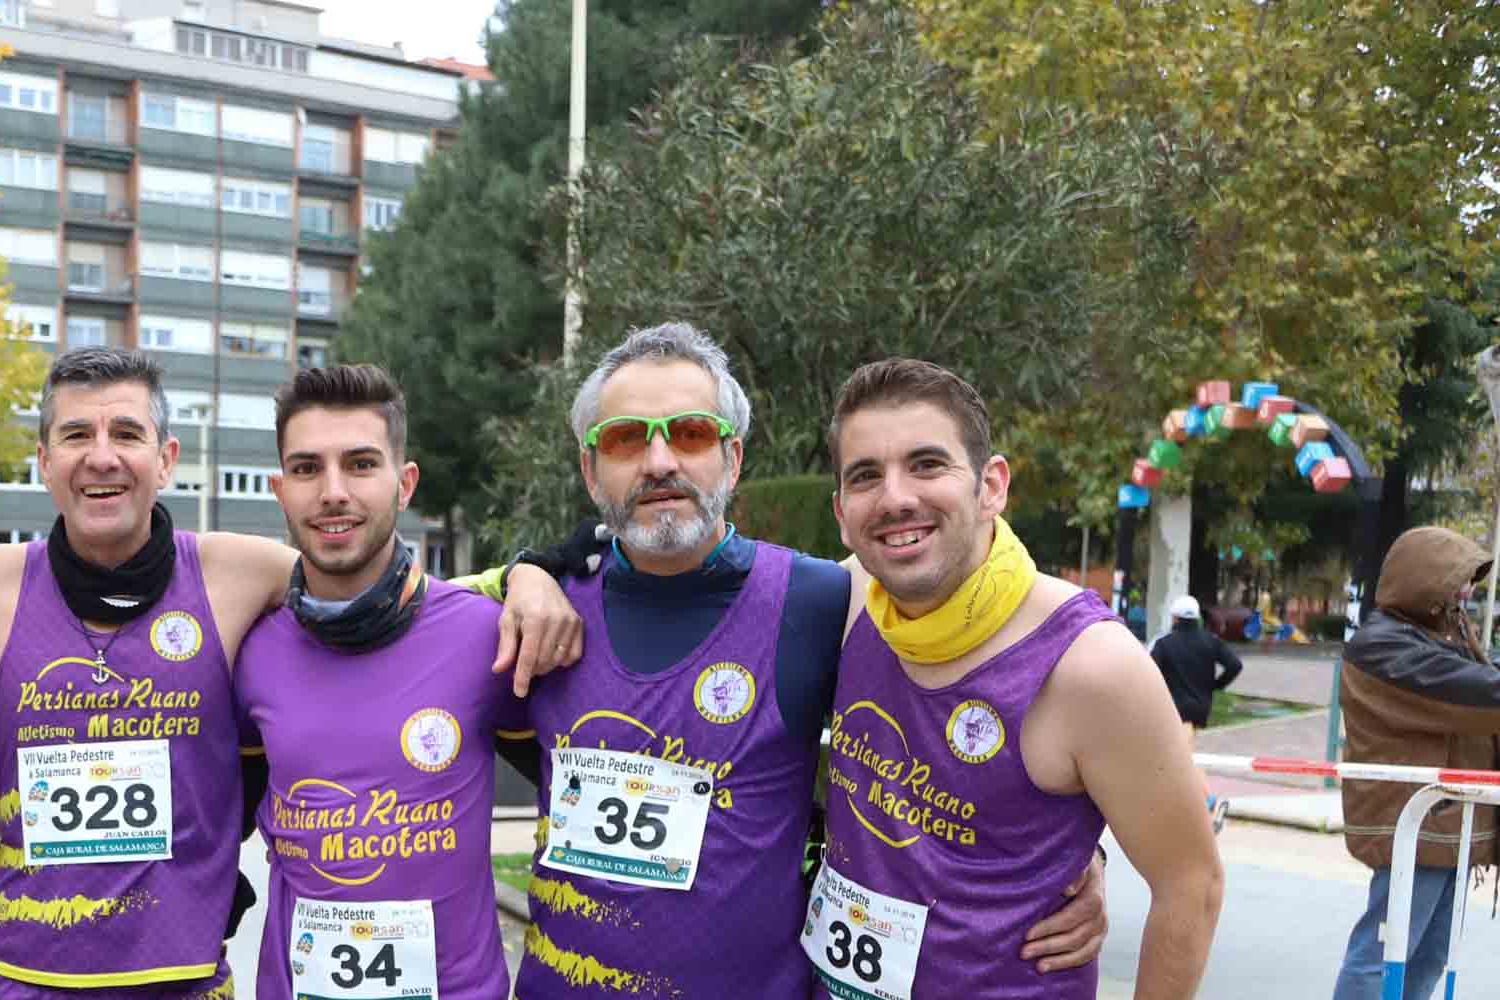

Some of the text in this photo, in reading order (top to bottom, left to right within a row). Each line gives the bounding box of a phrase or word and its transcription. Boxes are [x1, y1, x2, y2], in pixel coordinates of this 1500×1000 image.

[17, 678, 201, 712] Persianas Ruano
[87, 712, 200, 738] Macotera
[36, 751, 67, 764] Vuelta
[70, 750, 114, 762] Pedestre
[559, 752, 572, 767] VII
[574, 753, 605, 770] Vuelta
[608, 757, 654, 777] Pedestre
[829, 711, 903, 781] Persianas
[902, 756, 977, 820] Ruano
[35, 767, 82, 778] Salamanca
[51, 783, 157, 832] 328
[361, 790, 453, 826] Ruano
[868, 781, 977, 846] Macotera
[594, 797, 670, 850] 35
[45, 847, 65, 856] CAJA
[109, 842, 165, 853] SALAMANCA
[321, 826, 457, 862] Macotera
[565, 854, 587, 867] CAJA
[588, 858, 613, 871] RURAL
[615, 862, 627, 873] DE
[838, 882, 870, 909] Pedestre
[303, 919, 342, 932] Salamanca
[306, 904, 330, 920] Vuelta
[332, 907, 375, 921] Pedestre
[826, 920, 882, 983] 38
[331, 943, 402, 989] 34
[402, 987, 432, 995] DAVID
